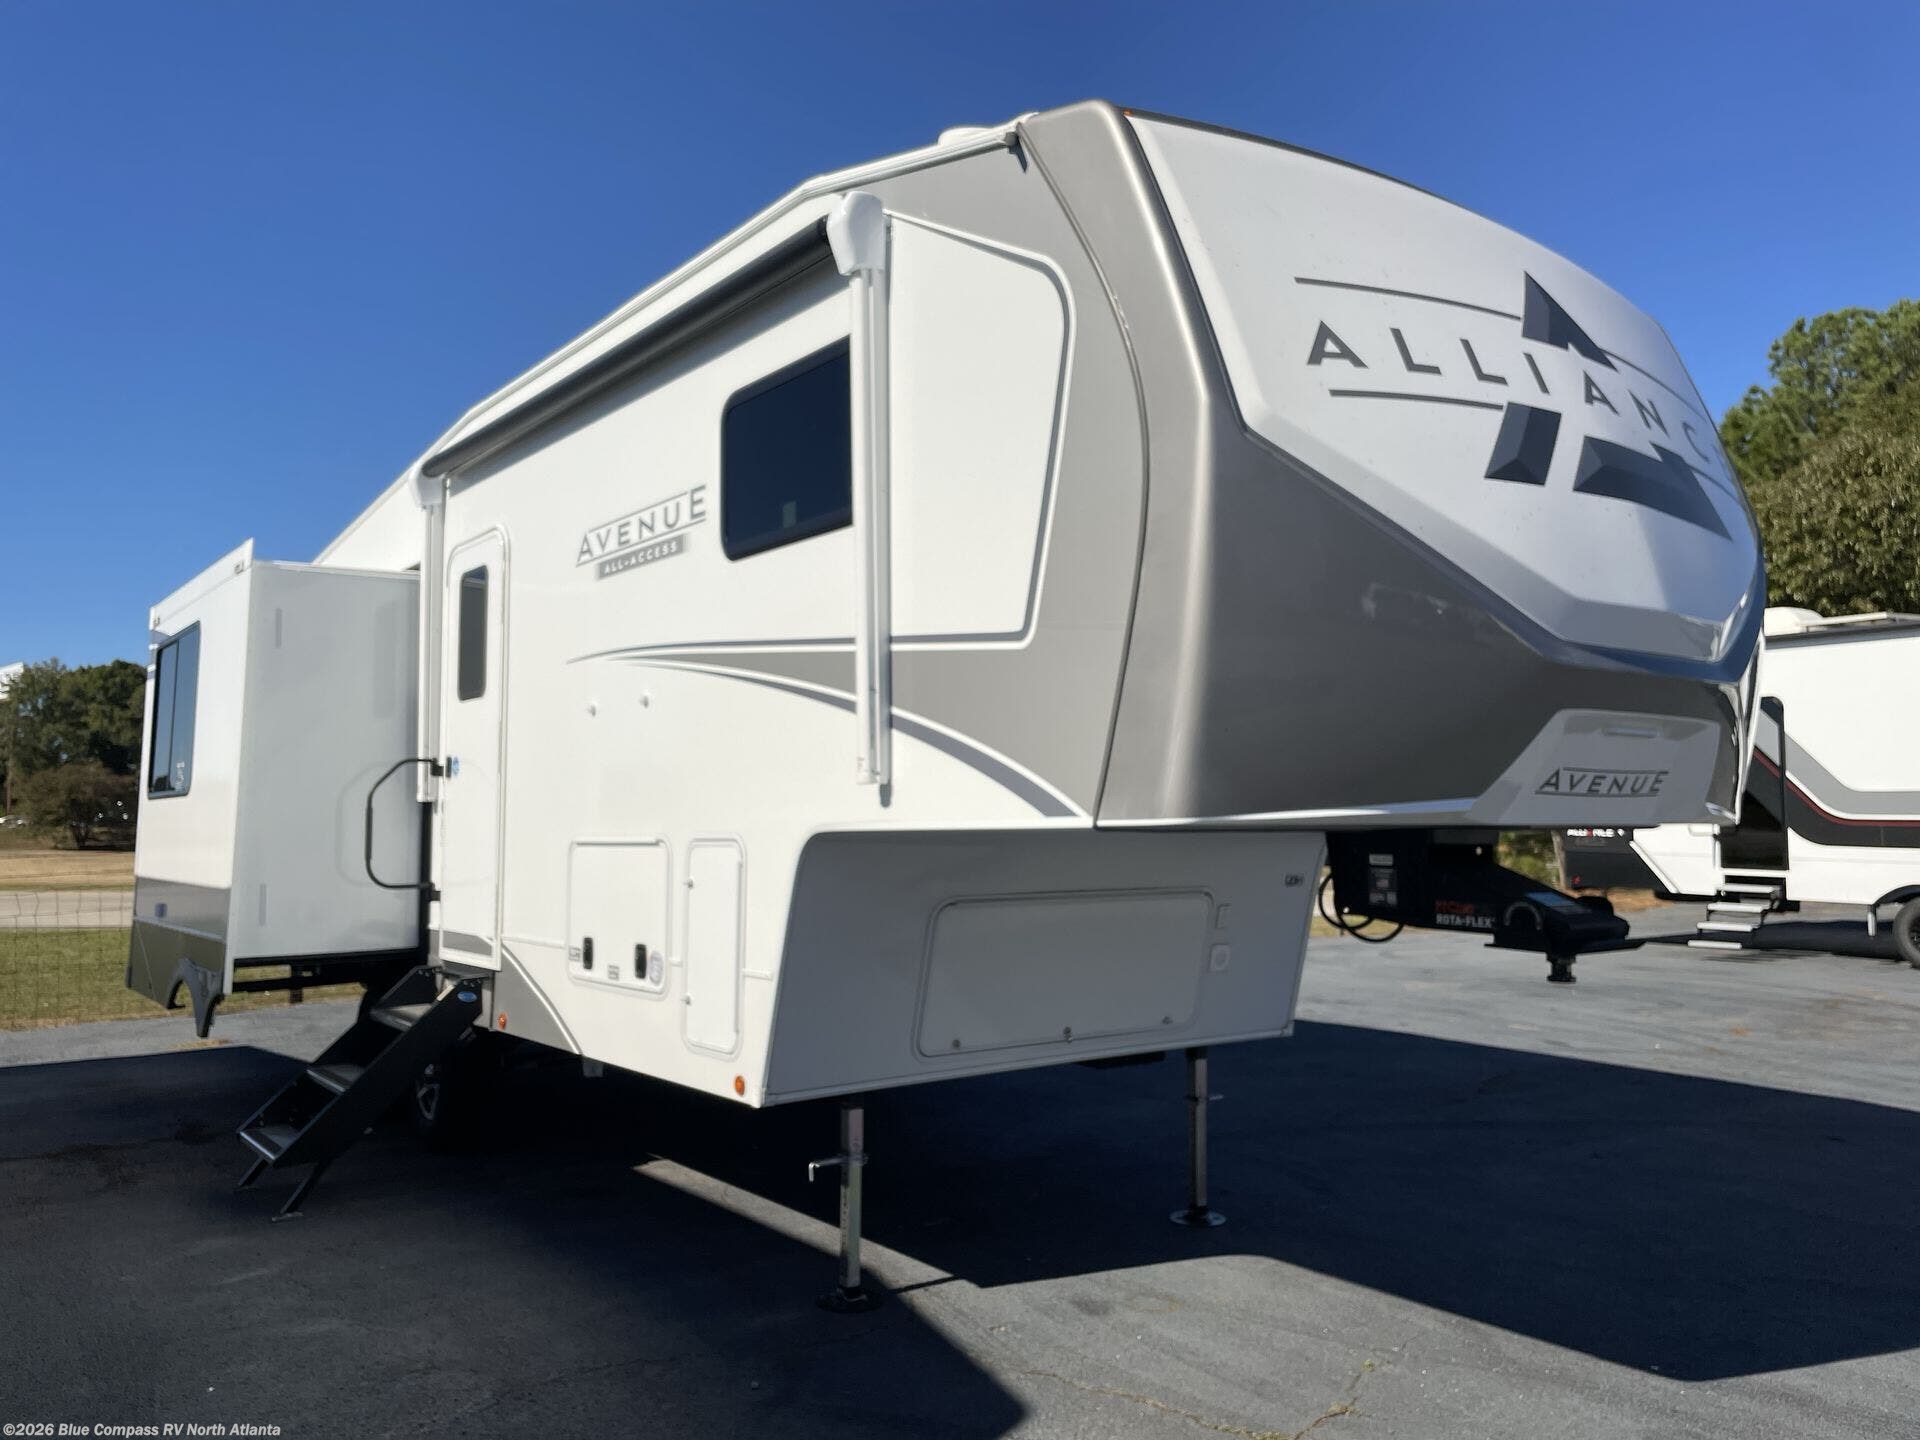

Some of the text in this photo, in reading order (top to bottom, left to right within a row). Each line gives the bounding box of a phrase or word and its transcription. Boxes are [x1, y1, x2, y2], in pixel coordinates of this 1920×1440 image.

[1307, 320, 1722, 470] ALLIANC
[577, 484, 707, 563] AVENUE
[1538, 768, 1670, 795] AVENUE
